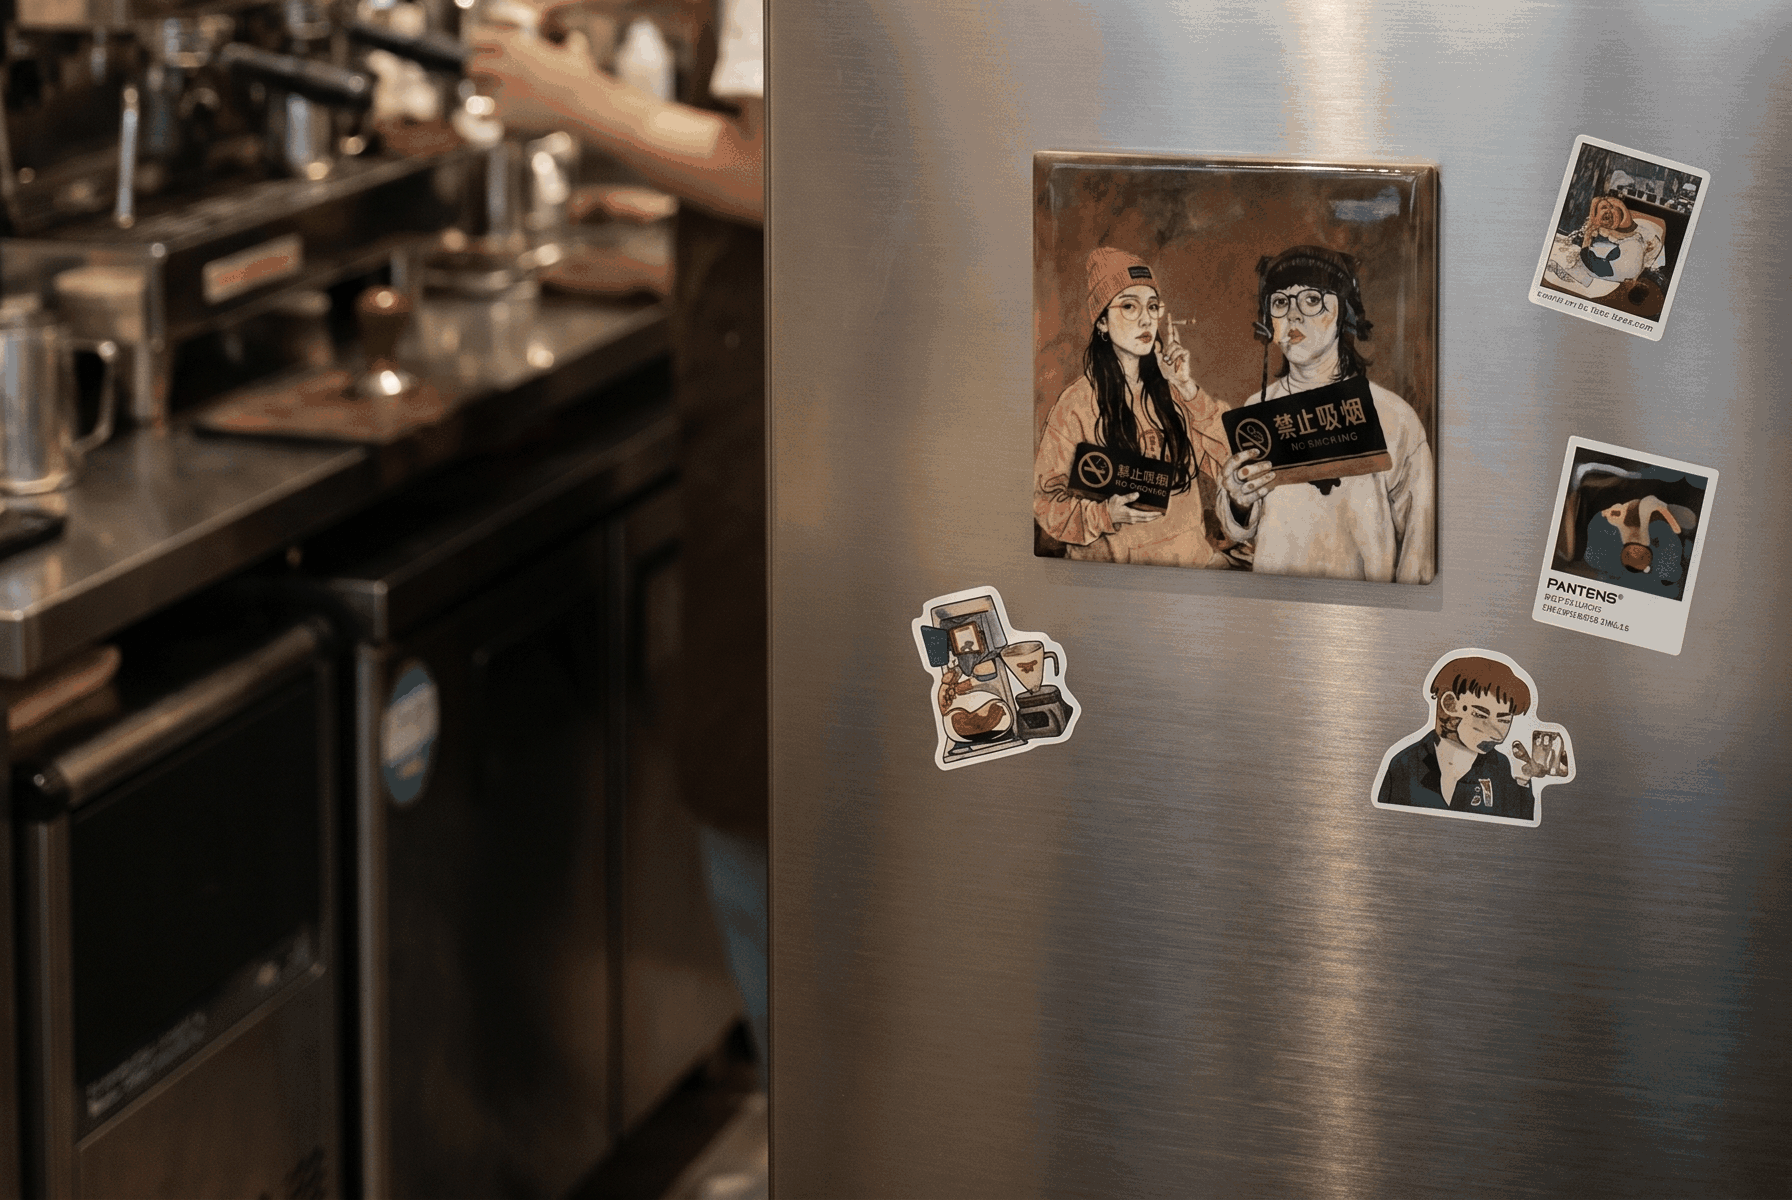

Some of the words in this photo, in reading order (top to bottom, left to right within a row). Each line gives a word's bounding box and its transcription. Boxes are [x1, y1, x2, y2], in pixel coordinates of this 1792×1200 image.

[1273, 397, 1367, 440] 禁止吸烟
[1546, 578, 1618, 604] PANTENS
